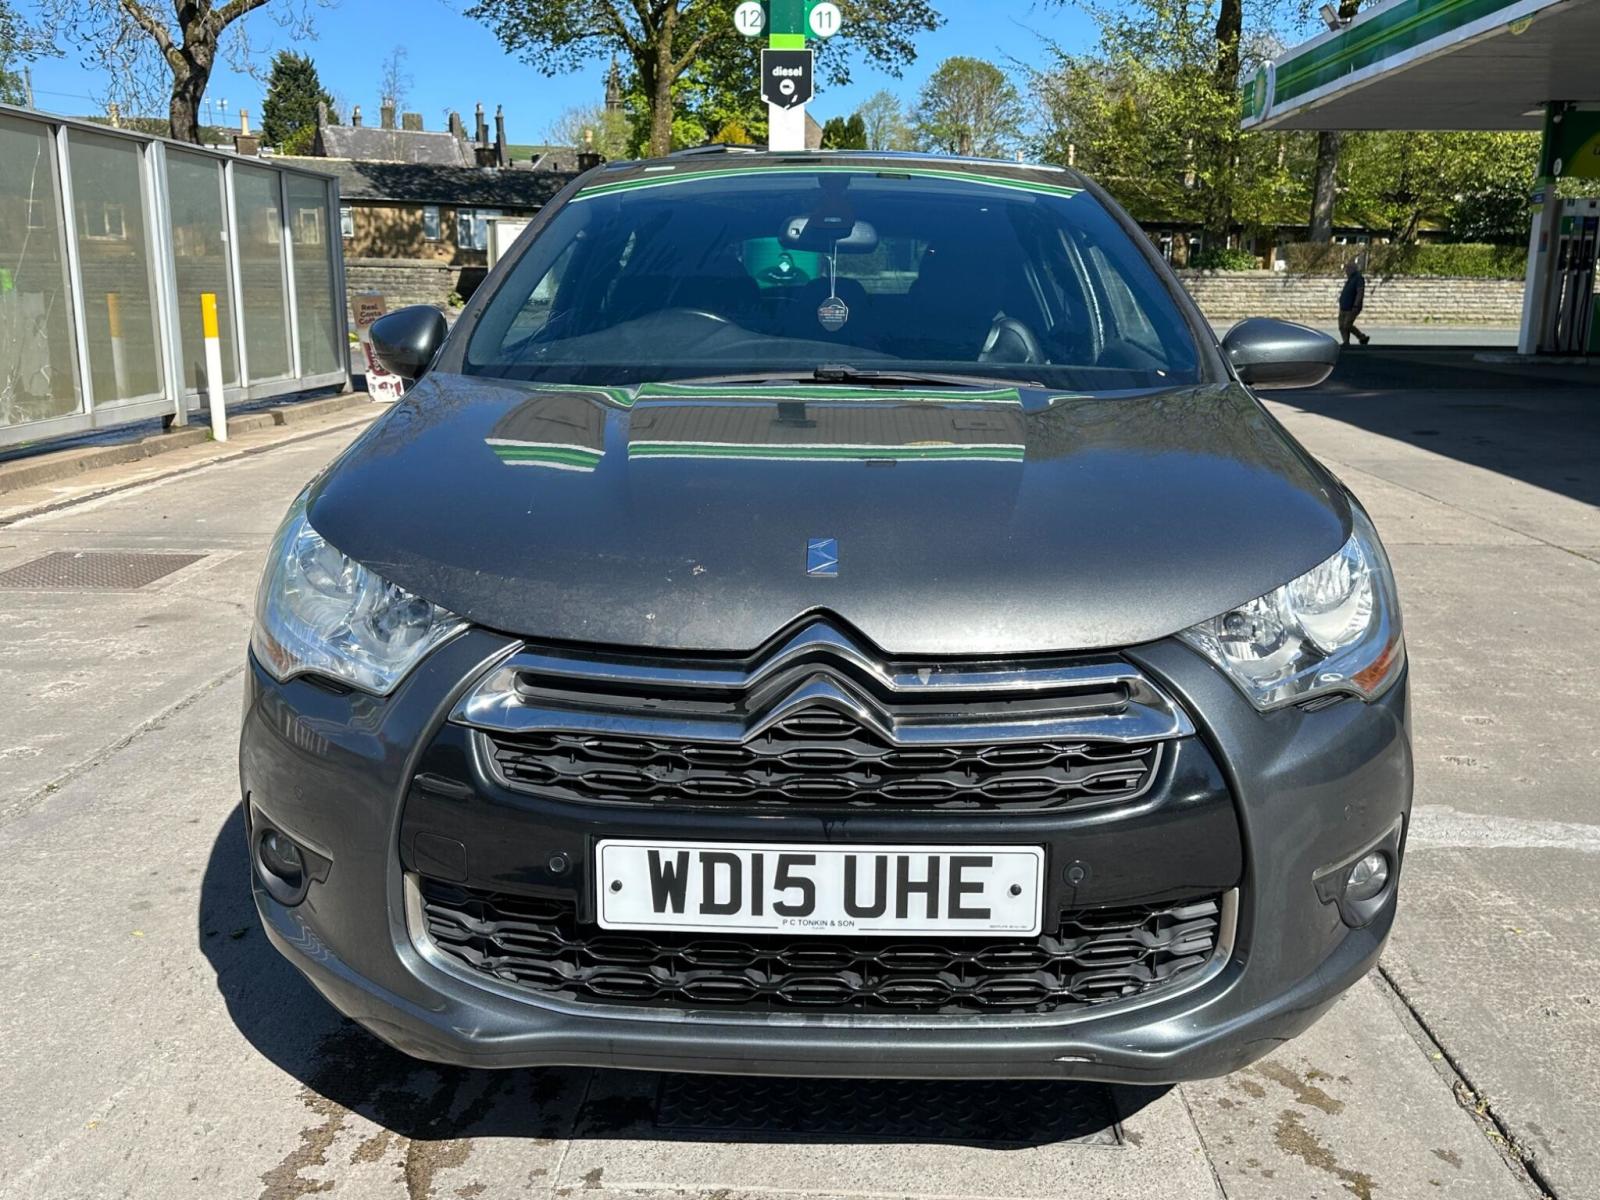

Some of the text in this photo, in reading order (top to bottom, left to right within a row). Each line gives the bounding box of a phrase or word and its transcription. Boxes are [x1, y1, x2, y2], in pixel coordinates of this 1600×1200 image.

[740, 9, 761, 27] 12
[816, 11, 832, 29] 11
[772, 66, 802, 76] diesel
[647, 850, 993, 920] WD15 UHE
